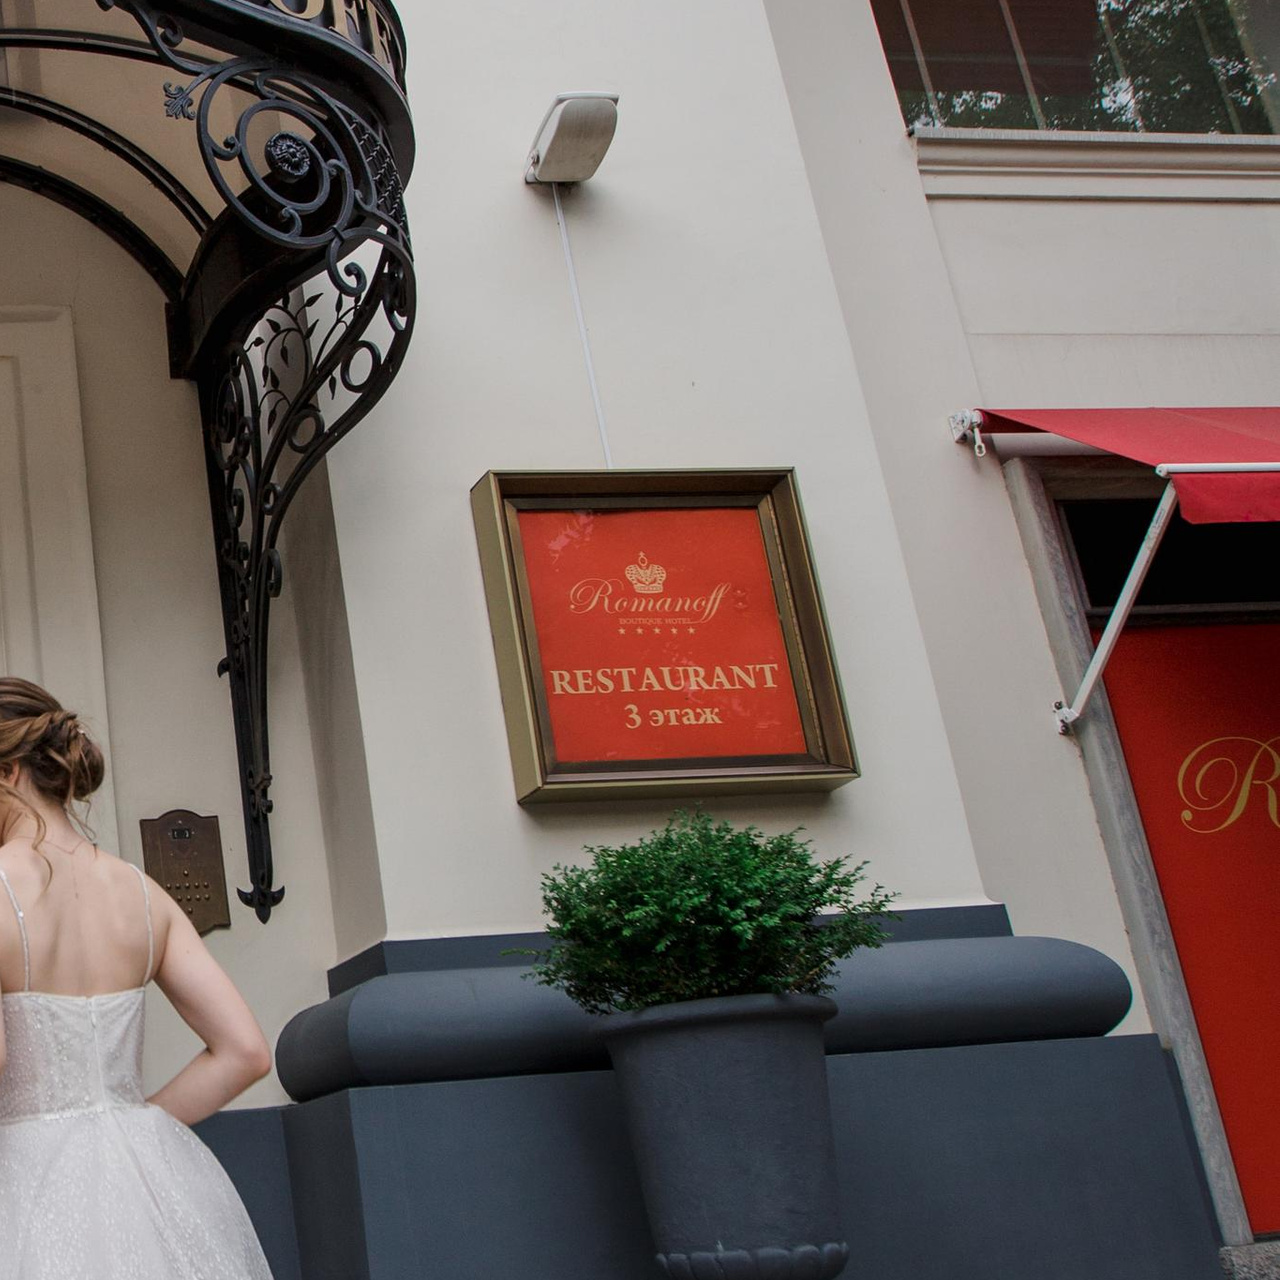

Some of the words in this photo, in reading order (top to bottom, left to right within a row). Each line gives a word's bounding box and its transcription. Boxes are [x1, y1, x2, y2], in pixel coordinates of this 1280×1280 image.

[570, 578, 731, 624] Romanoff
[550, 663, 778, 695] RESTAURANT
[624, 704, 642, 730] 3
[649, 706, 723, 728] этаж
